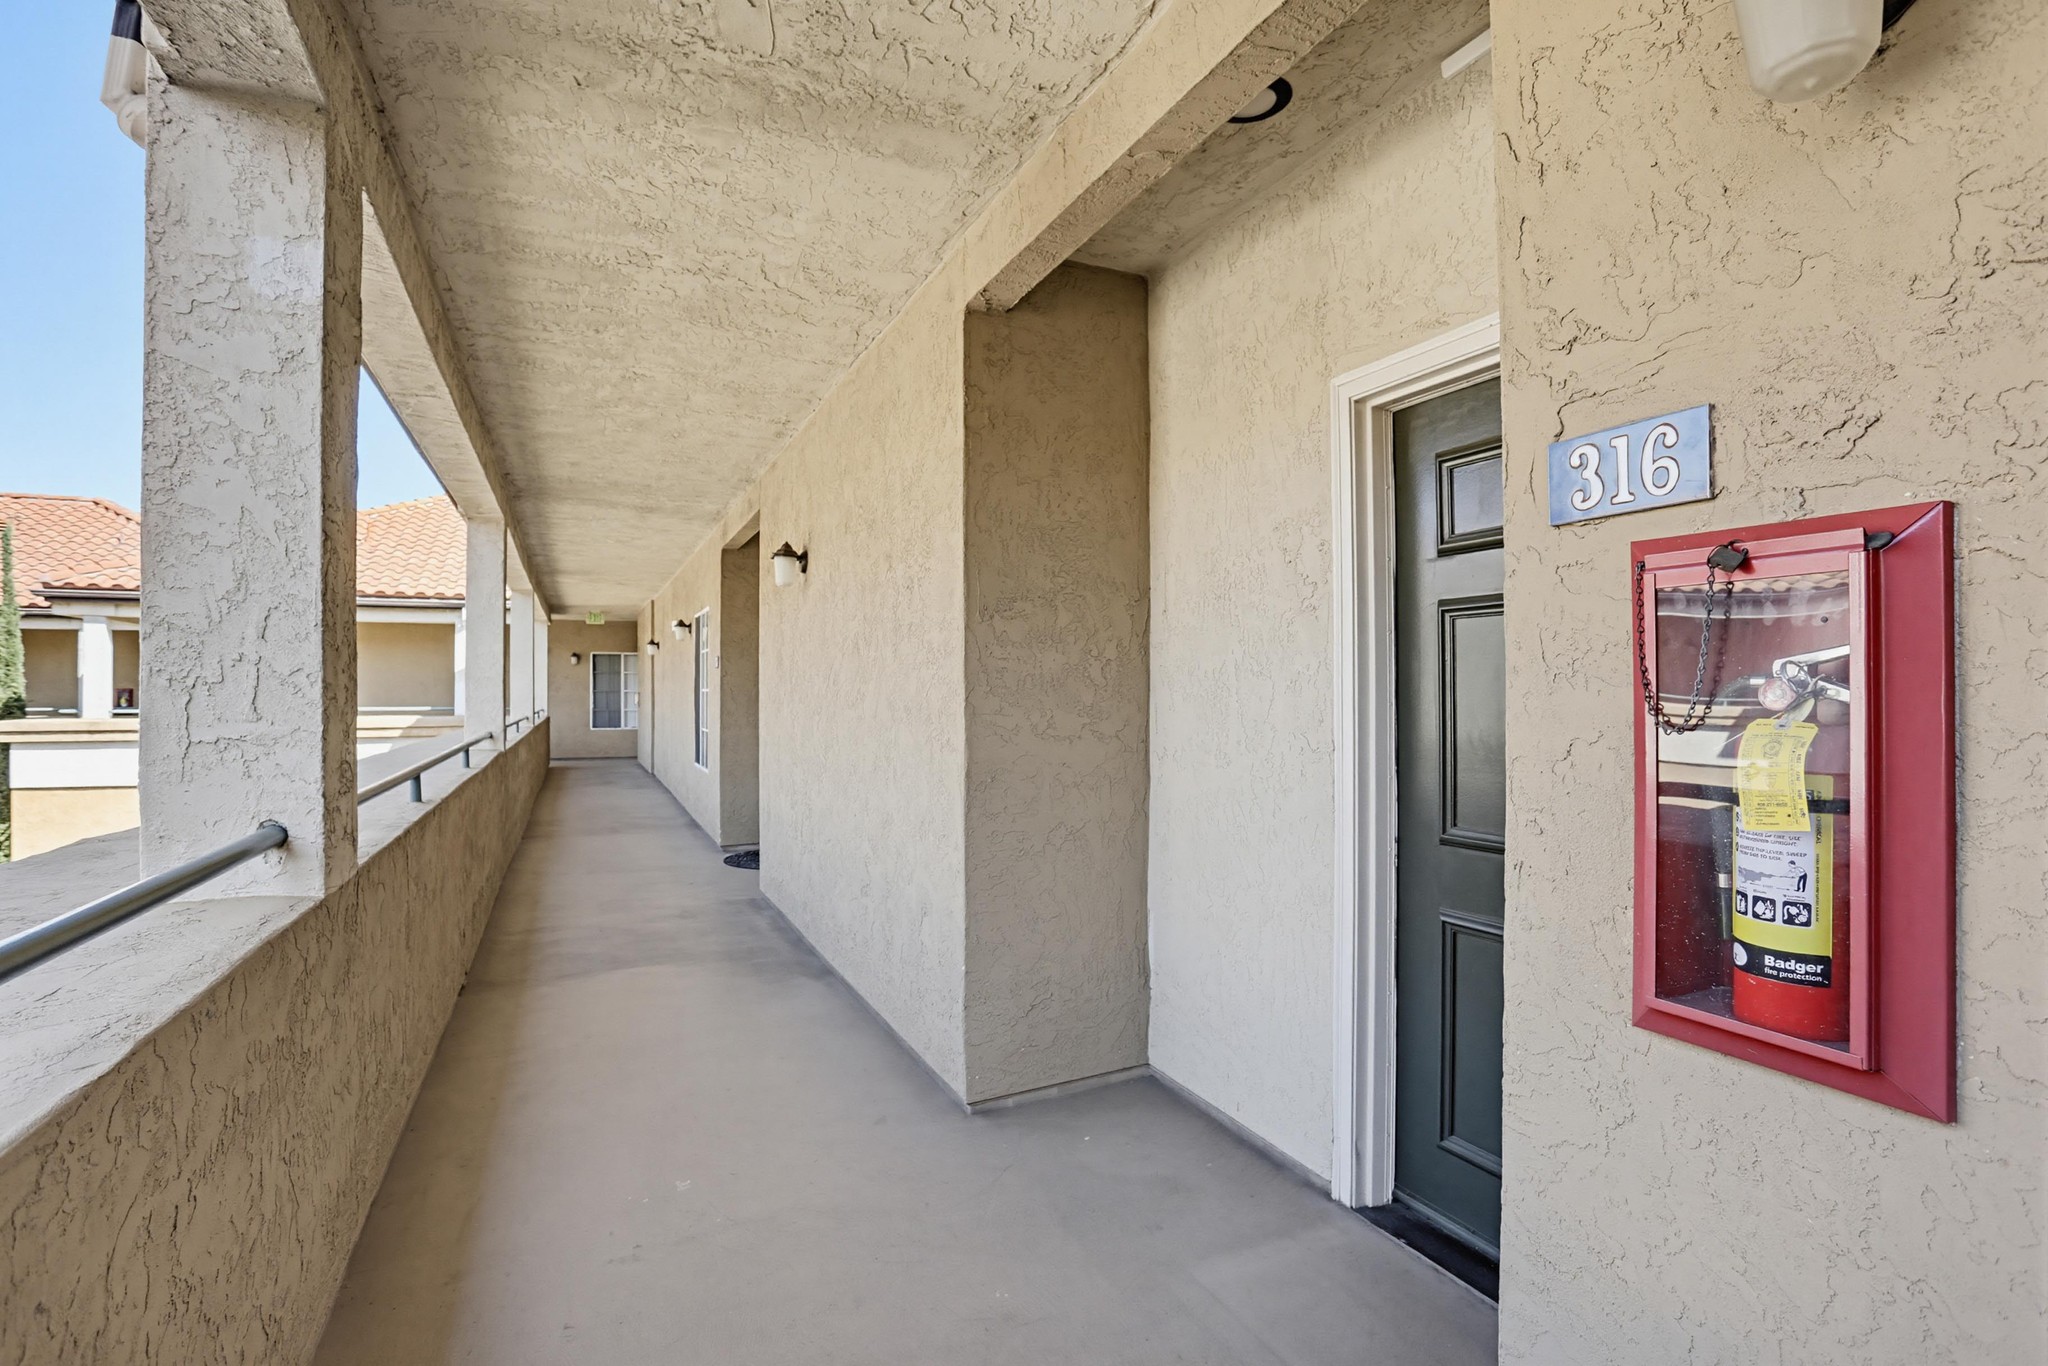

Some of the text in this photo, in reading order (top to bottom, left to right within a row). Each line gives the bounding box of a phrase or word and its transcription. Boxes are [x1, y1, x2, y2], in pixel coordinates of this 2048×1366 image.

[1569, 422, 1680, 511] 316
[1764, 954, 1824, 974] Badger
[1764, 966, 1822, 982] fire protection
